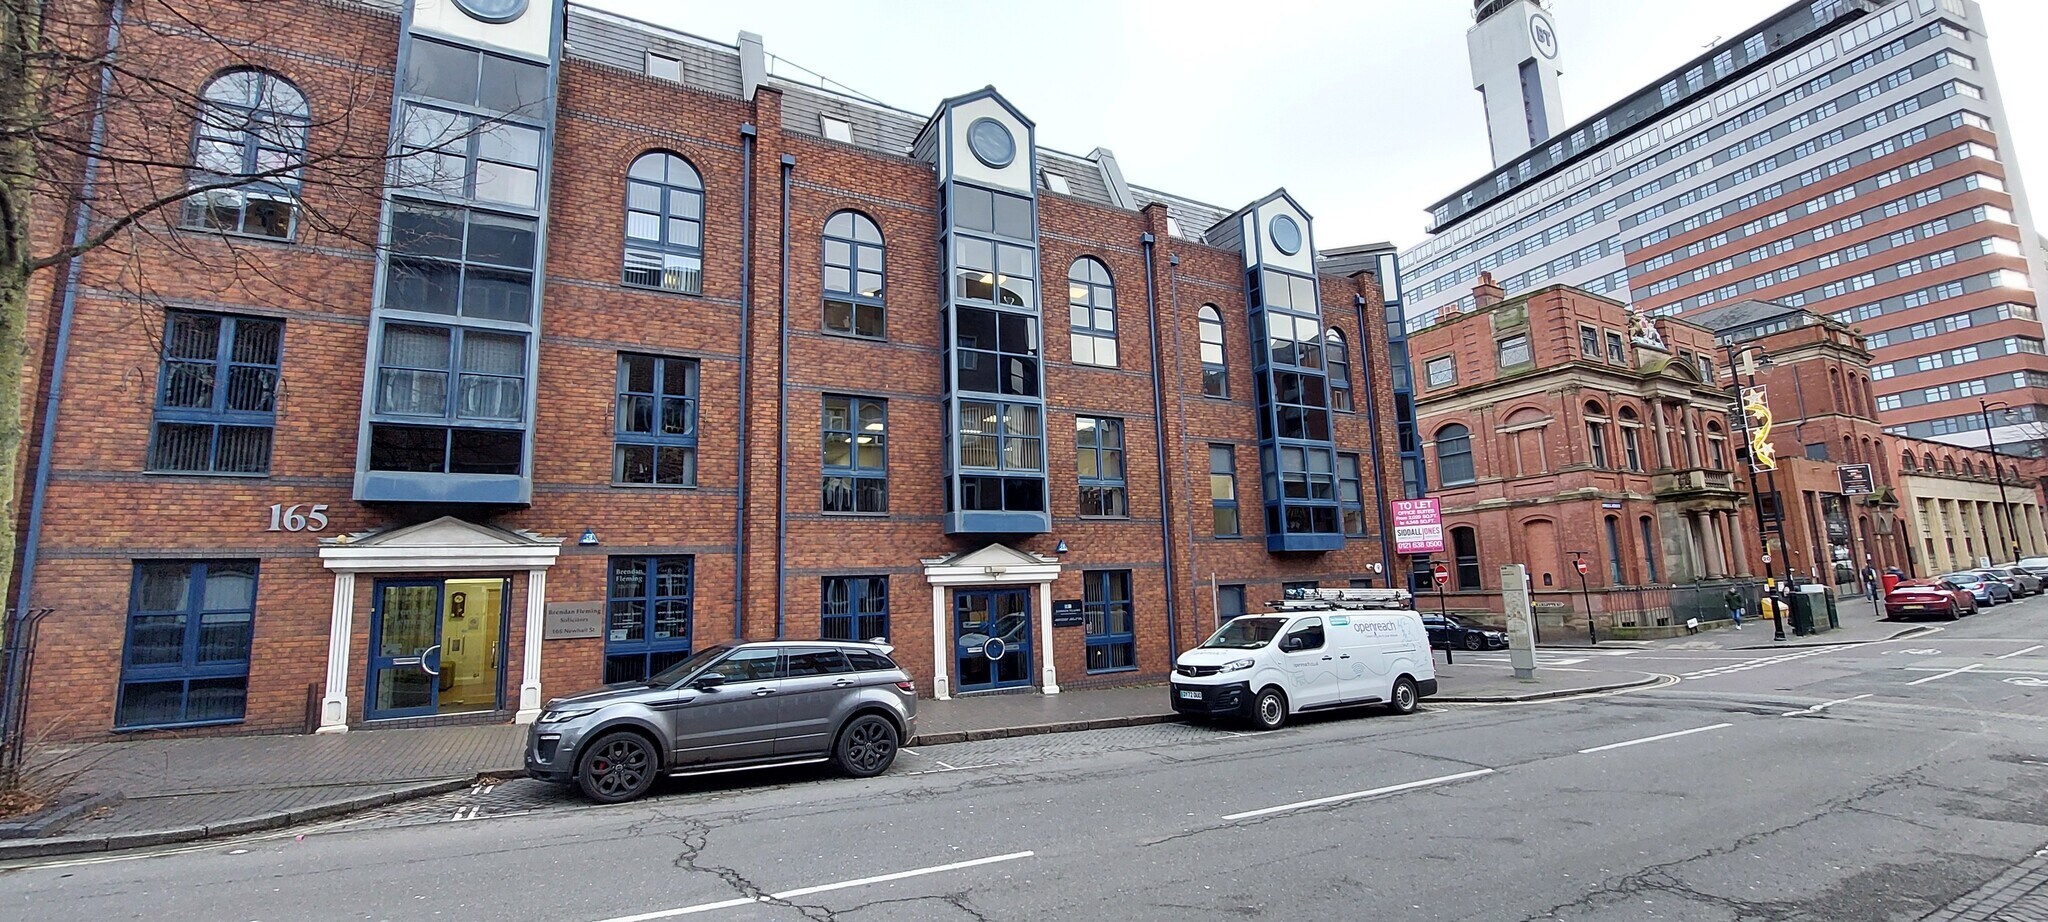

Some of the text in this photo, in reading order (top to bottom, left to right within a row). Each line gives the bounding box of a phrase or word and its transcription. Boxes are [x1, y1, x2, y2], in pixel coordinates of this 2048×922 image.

[1536, 25, 1551, 47] BT
[1398, 500, 1432, 510] TO LET
[265, 503, 329, 532] 165
[1397, 528, 1422, 537] SIDDALL
[1353, 621, 1396, 633] openreach
